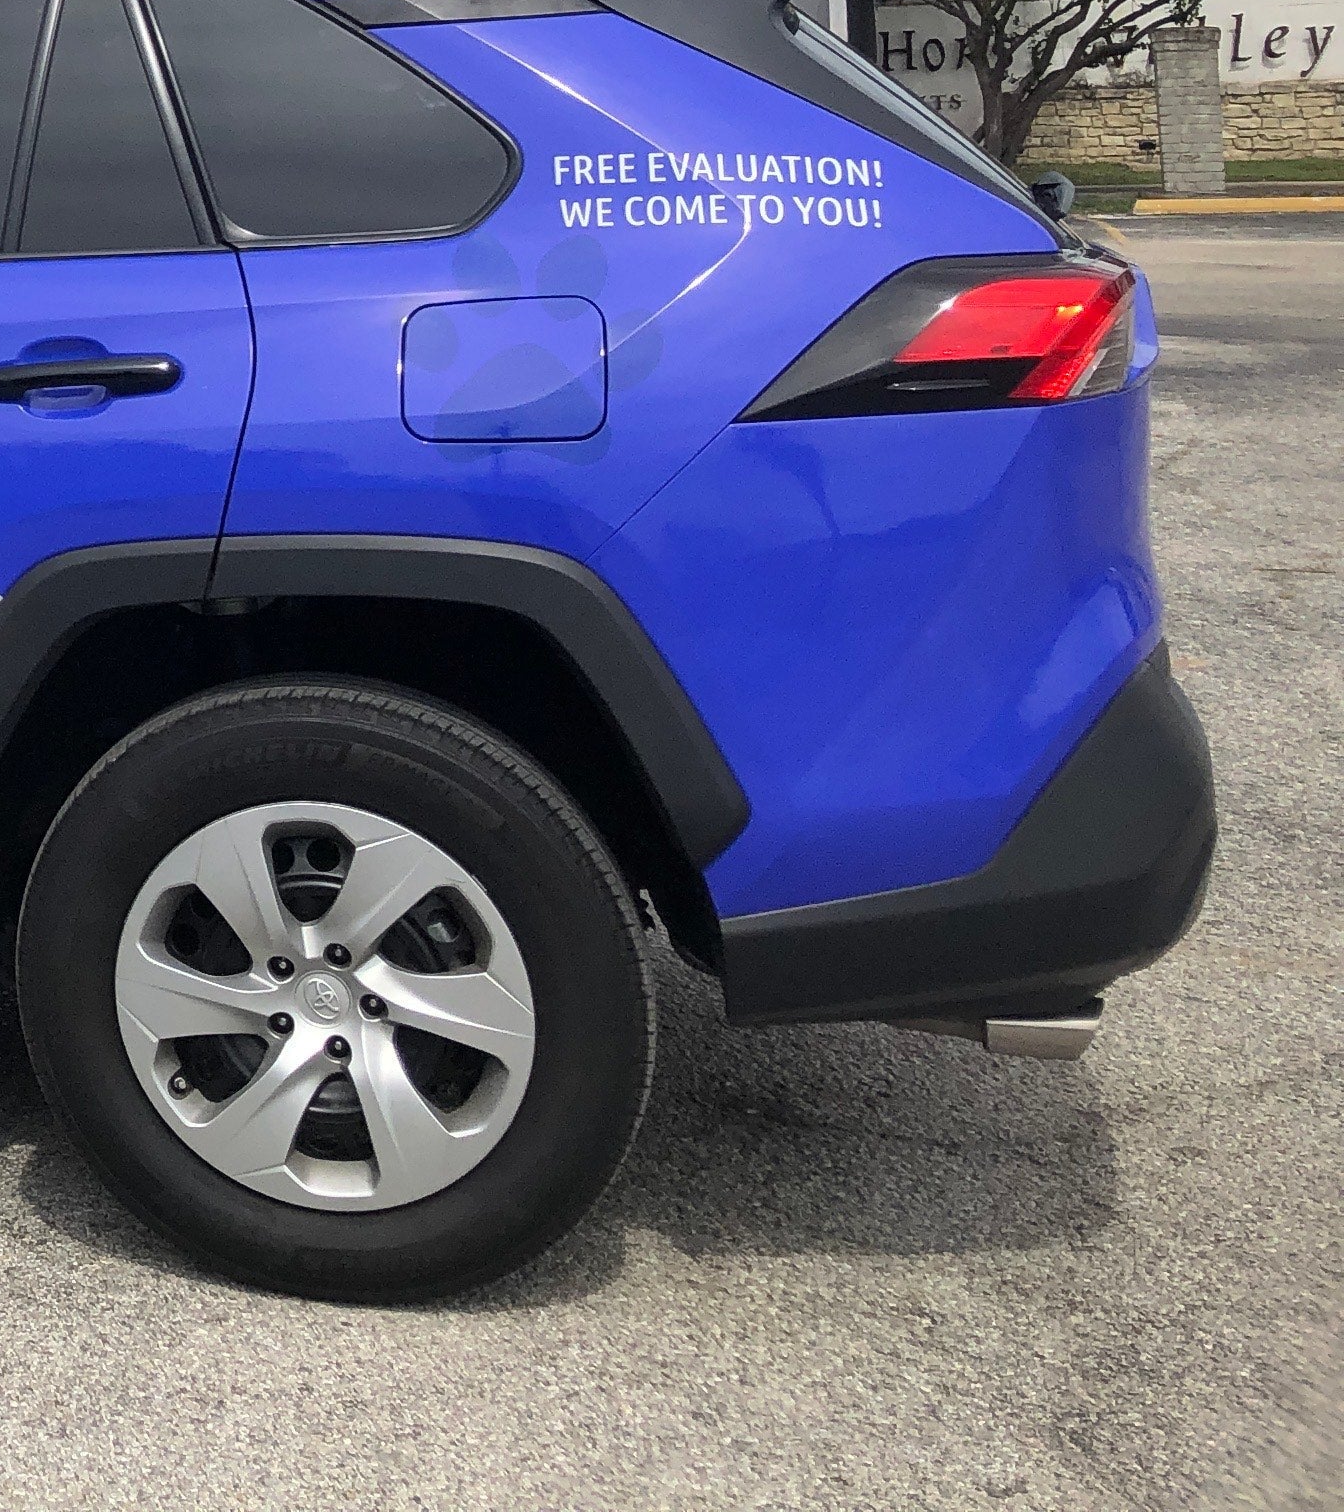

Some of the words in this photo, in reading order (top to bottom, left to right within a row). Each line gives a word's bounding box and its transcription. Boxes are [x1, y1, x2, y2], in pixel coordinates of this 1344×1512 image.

[553, 153, 637, 186] FREE
[648, 152, 884, 188] EVALUATION!
[560, 197, 614, 228] WE
[624, 195, 728, 227] COME
[736, 194, 785, 226] TO
[793, 195, 883, 228] YOU!
